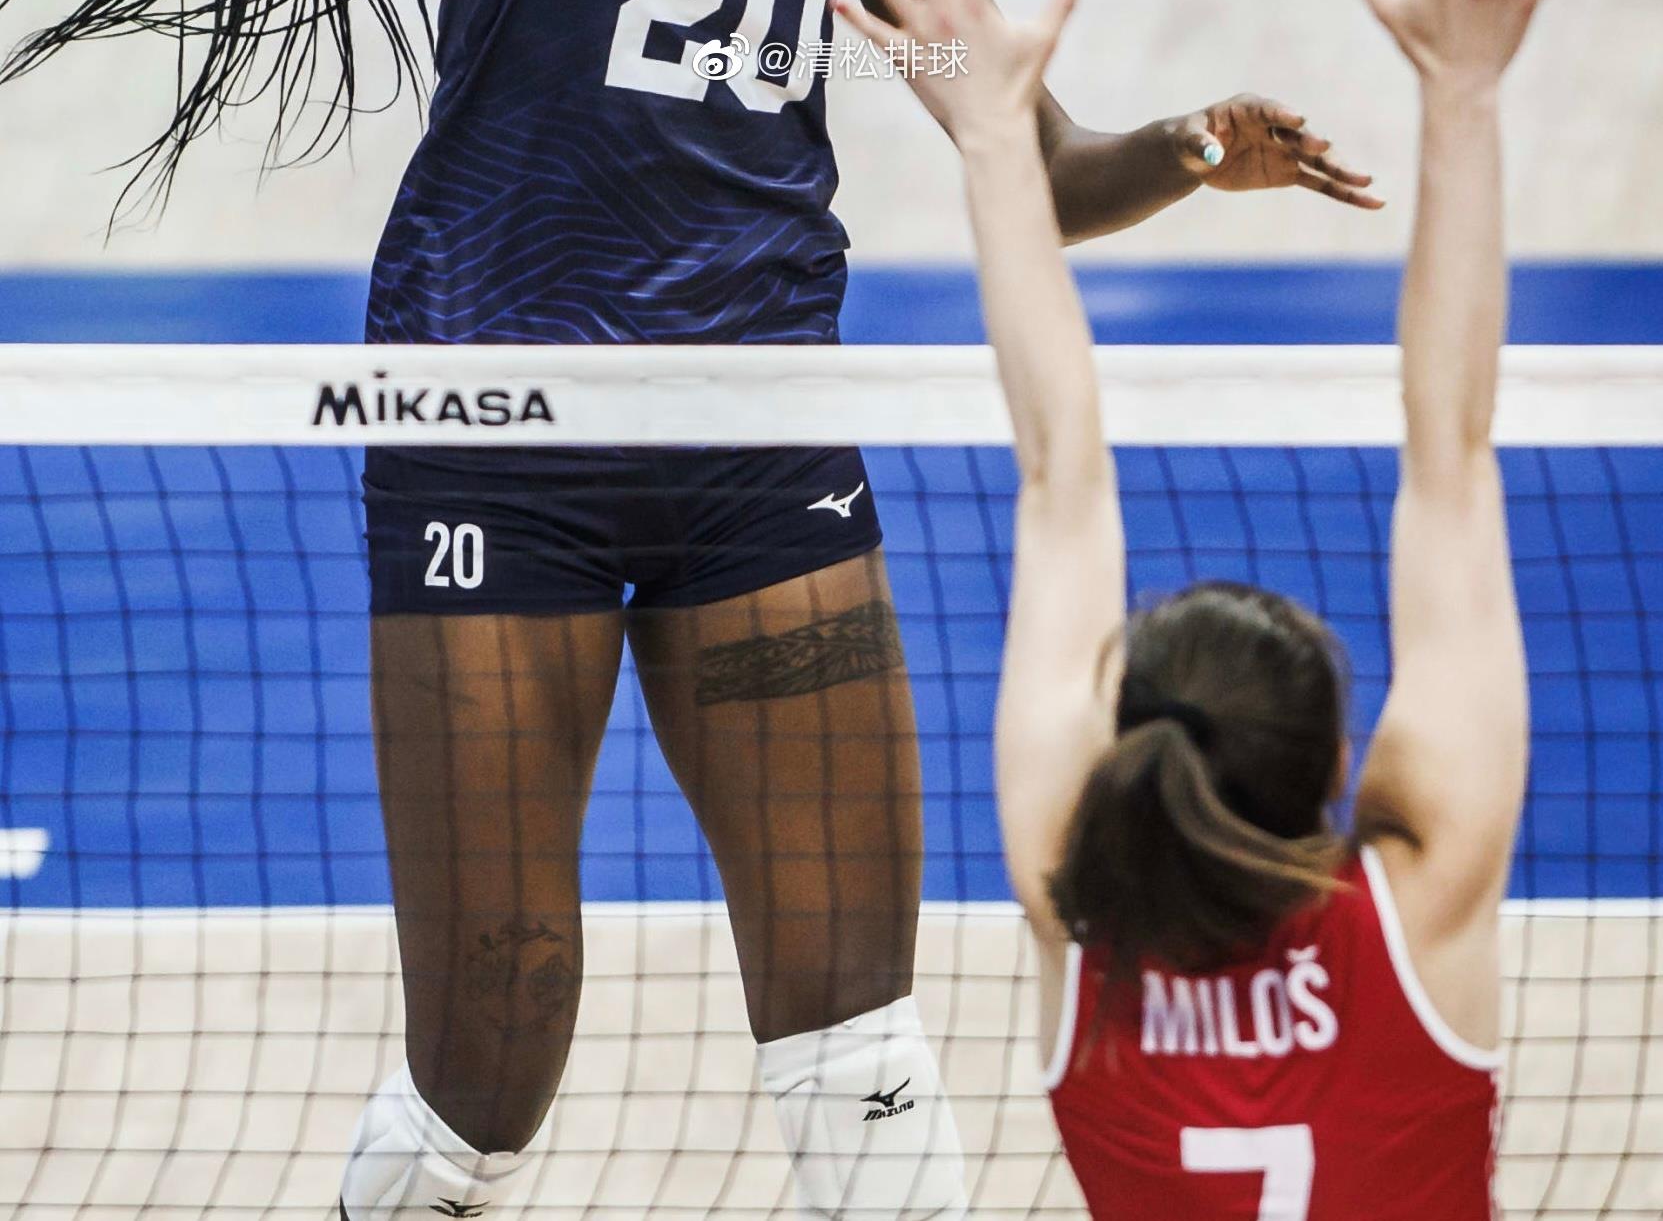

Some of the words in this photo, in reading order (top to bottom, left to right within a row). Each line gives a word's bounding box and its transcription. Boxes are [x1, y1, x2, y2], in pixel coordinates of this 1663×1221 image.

[424, 521, 485, 589] 20
[1140, 944, 1339, 1057] MILOŠ
[1179, 1123, 1317, 1221] 7
